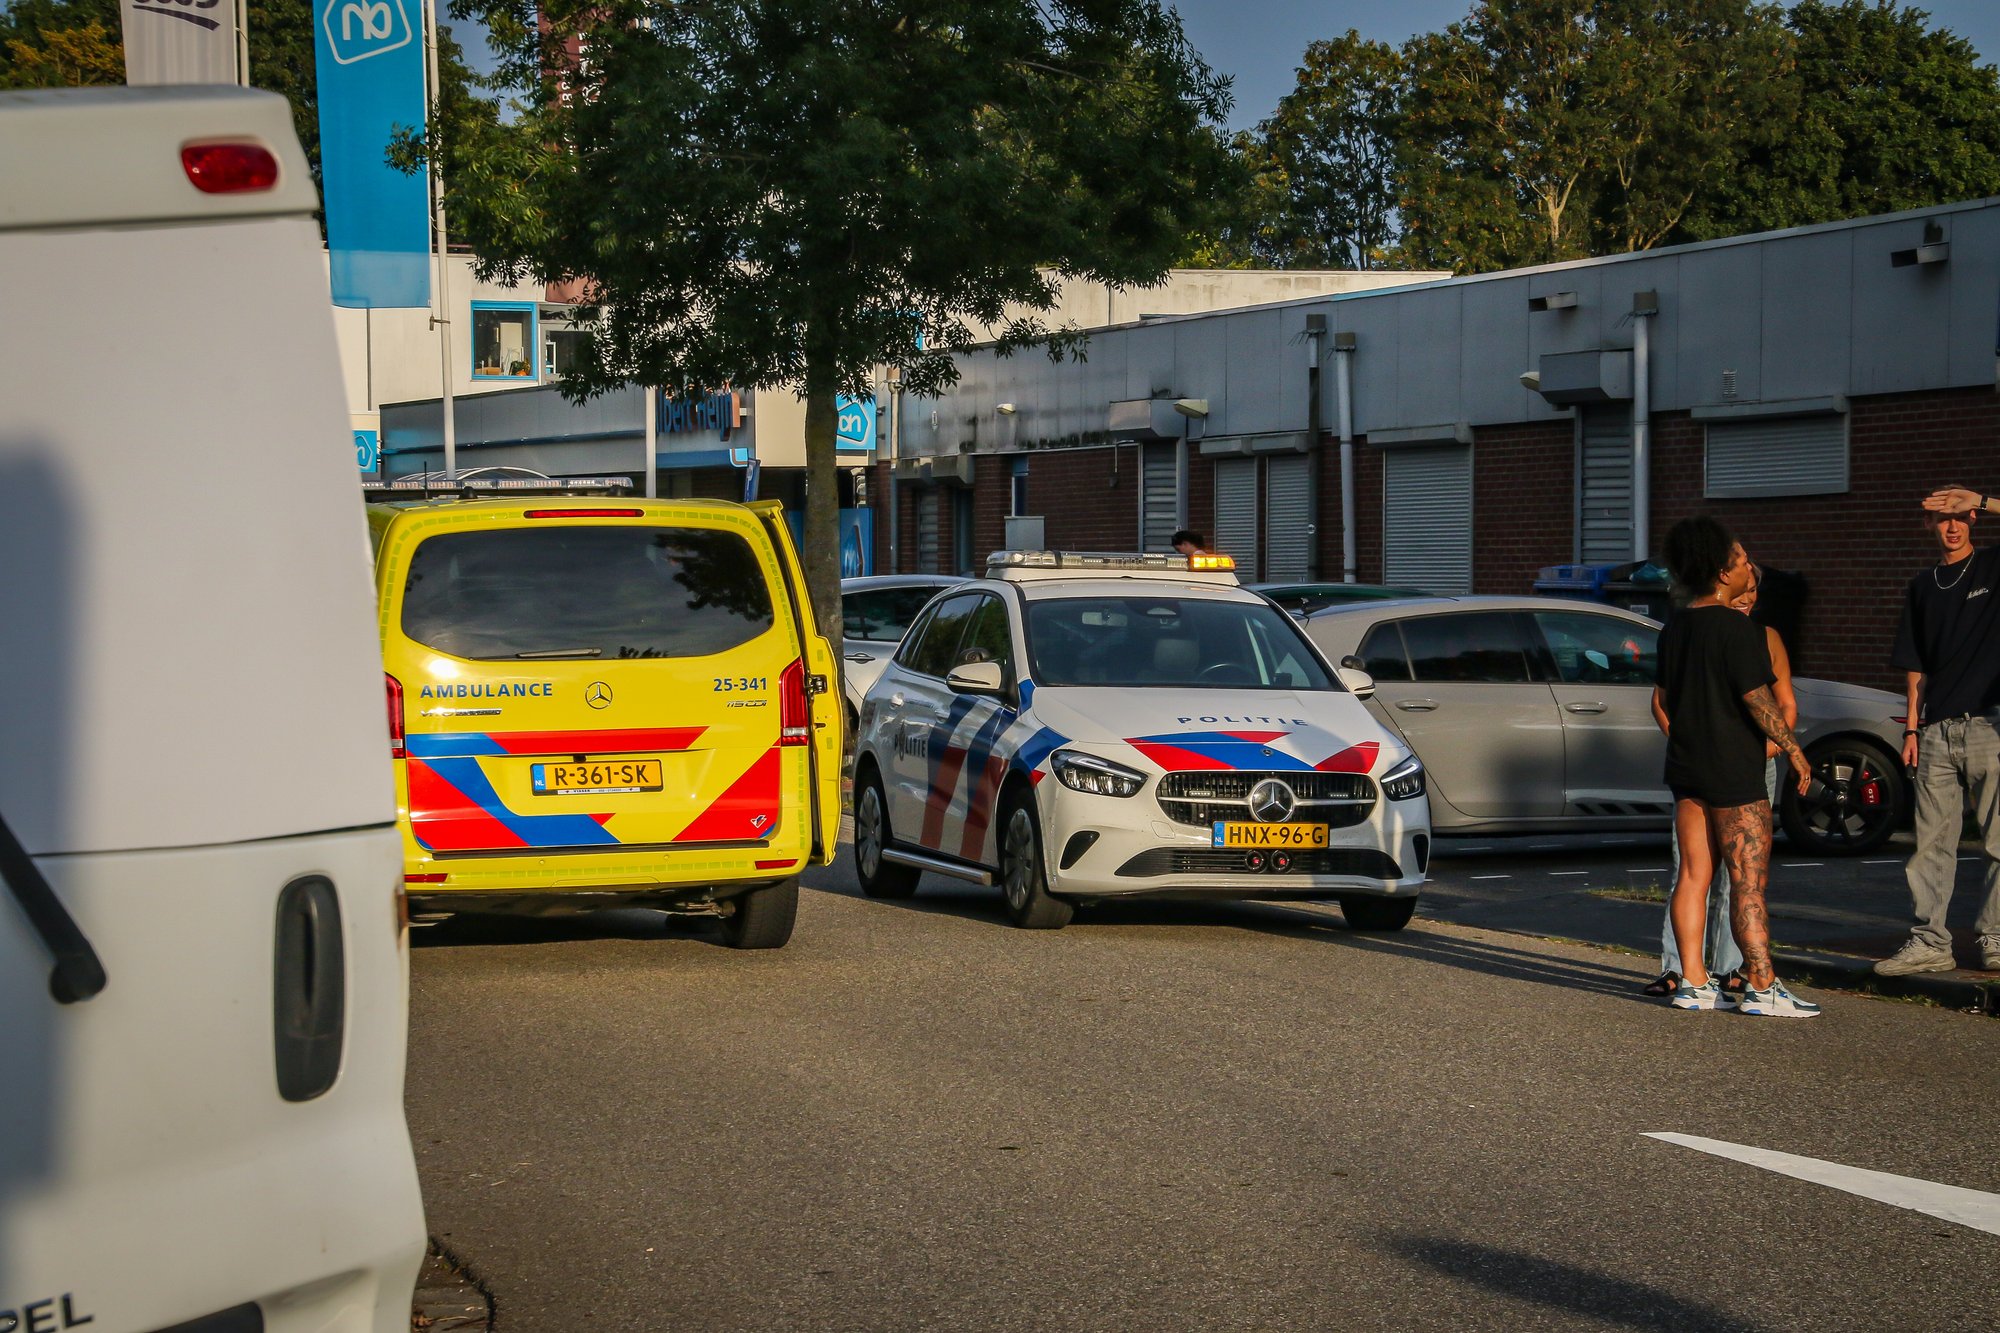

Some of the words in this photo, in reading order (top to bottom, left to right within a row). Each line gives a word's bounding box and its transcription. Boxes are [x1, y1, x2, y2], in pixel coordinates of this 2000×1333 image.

[420, 683, 553, 698] AMBULANCE
[713, 677, 767, 692] 25-341
[1177, 716, 1309, 727] POLITIE
[555, 765, 649, 786] R-361-SK
[1229, 826, 1323, 845] HNX-96-G
